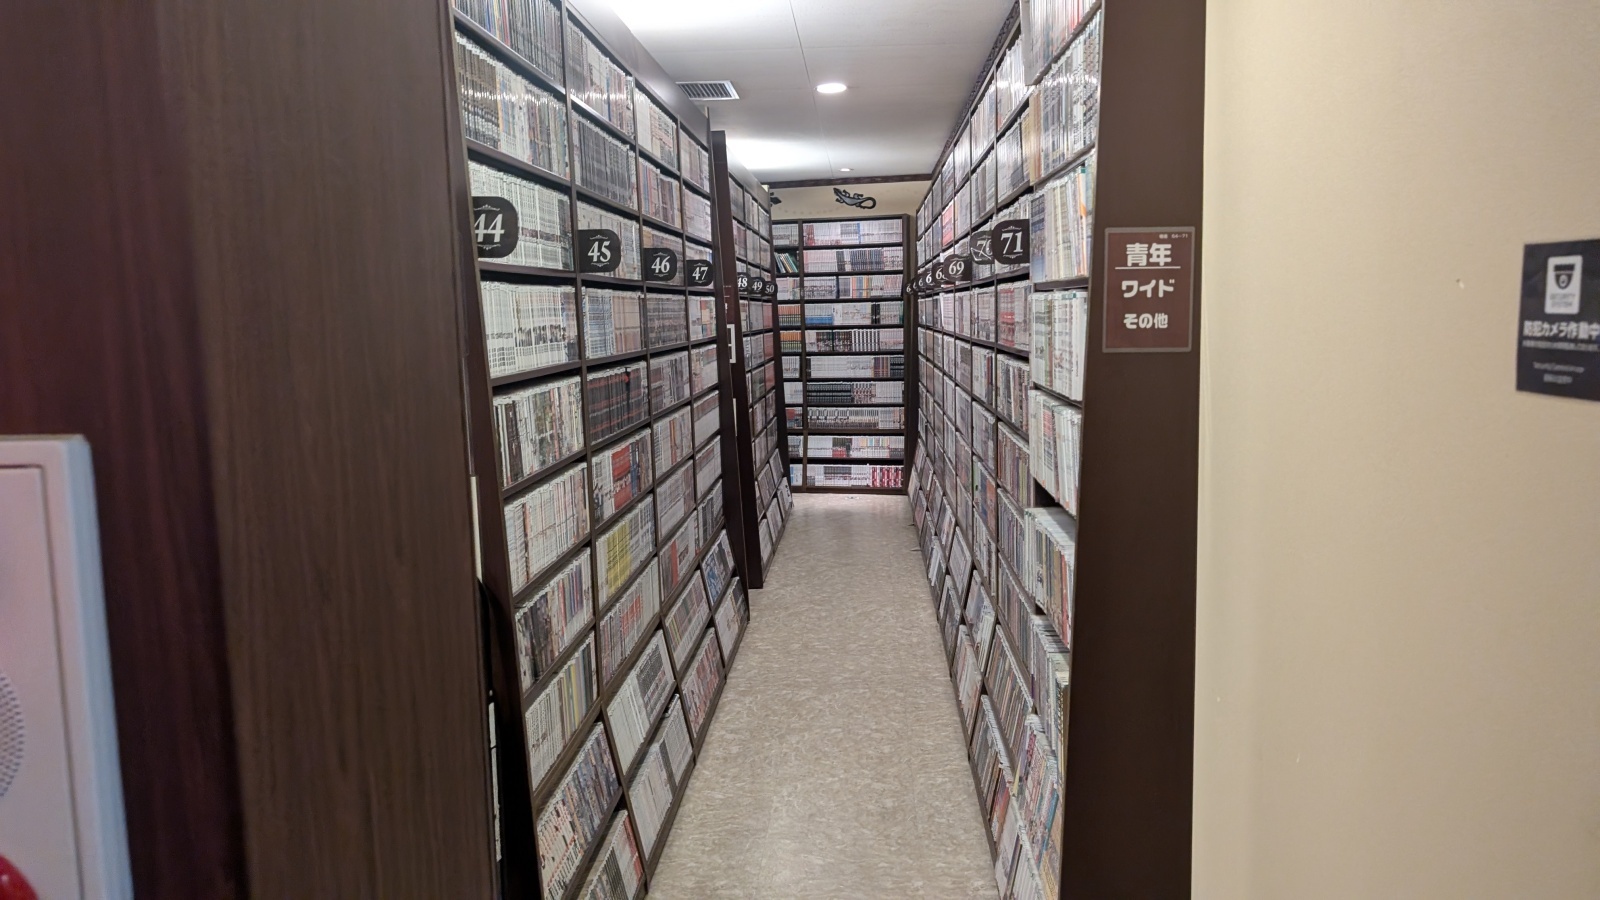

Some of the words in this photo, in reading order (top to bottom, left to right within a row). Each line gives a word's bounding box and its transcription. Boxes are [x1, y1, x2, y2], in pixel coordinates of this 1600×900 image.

[474, 213, 505, 243] 44
[587, 240, 612, 262] 45
[1000, 231, 1023, 254] 71
[1126, 243, 1172, 267] 青年
[651, 256, 671, 274] 46
[692, 266, 708, 281] 47
[948, 260, 965, 275] 69
[738, 277, 748, 288] 48
[752, 281, 763, 291] 49
[765, 284, 775, 293] 50
[1121, 279, 1175, 298] ワイド
[1123, 313, 1168, 329] その他
